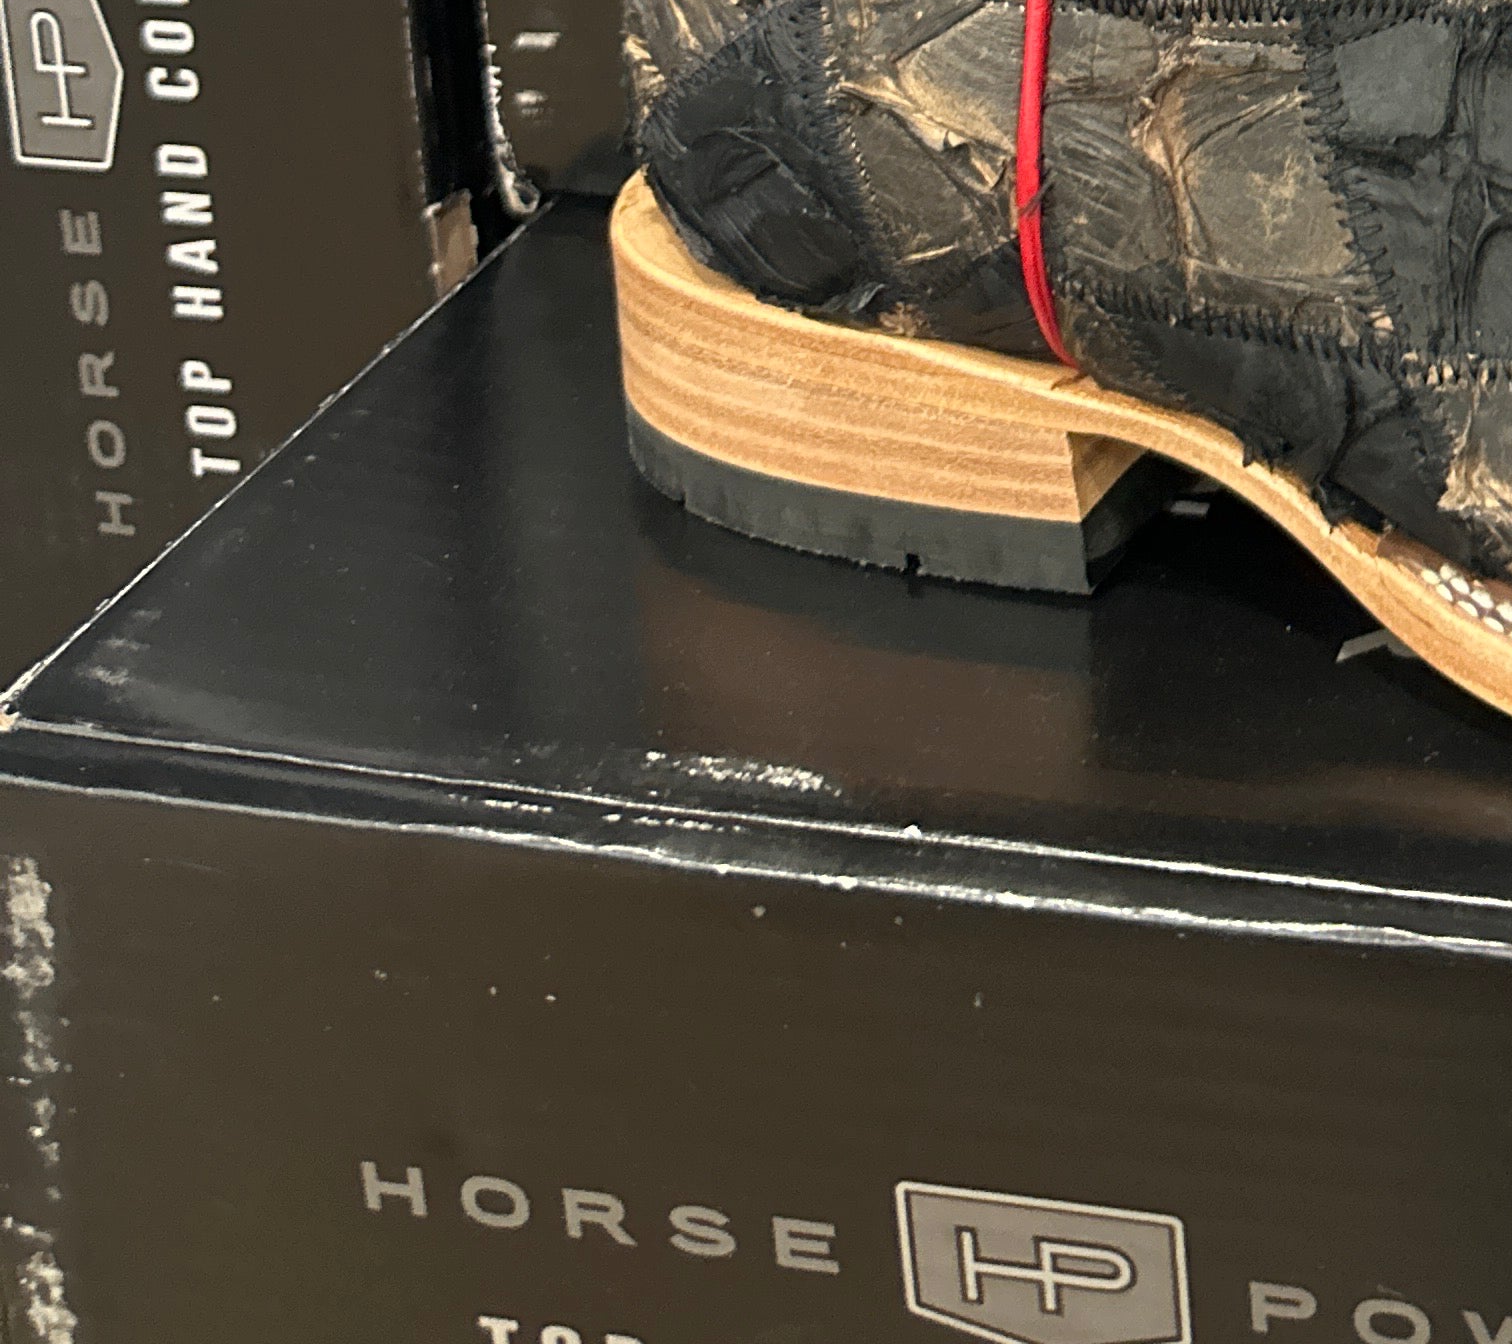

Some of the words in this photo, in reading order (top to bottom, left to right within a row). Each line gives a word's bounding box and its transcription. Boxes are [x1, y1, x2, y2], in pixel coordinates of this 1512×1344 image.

[154, 142, 225, 321] HAND
[58, 208, 137, 537] HORSE
[176, 355, 243, 479] TOP
[359, 1161, 840, 1275] HORSE
[956, 1227, 1136, 1312] HP
